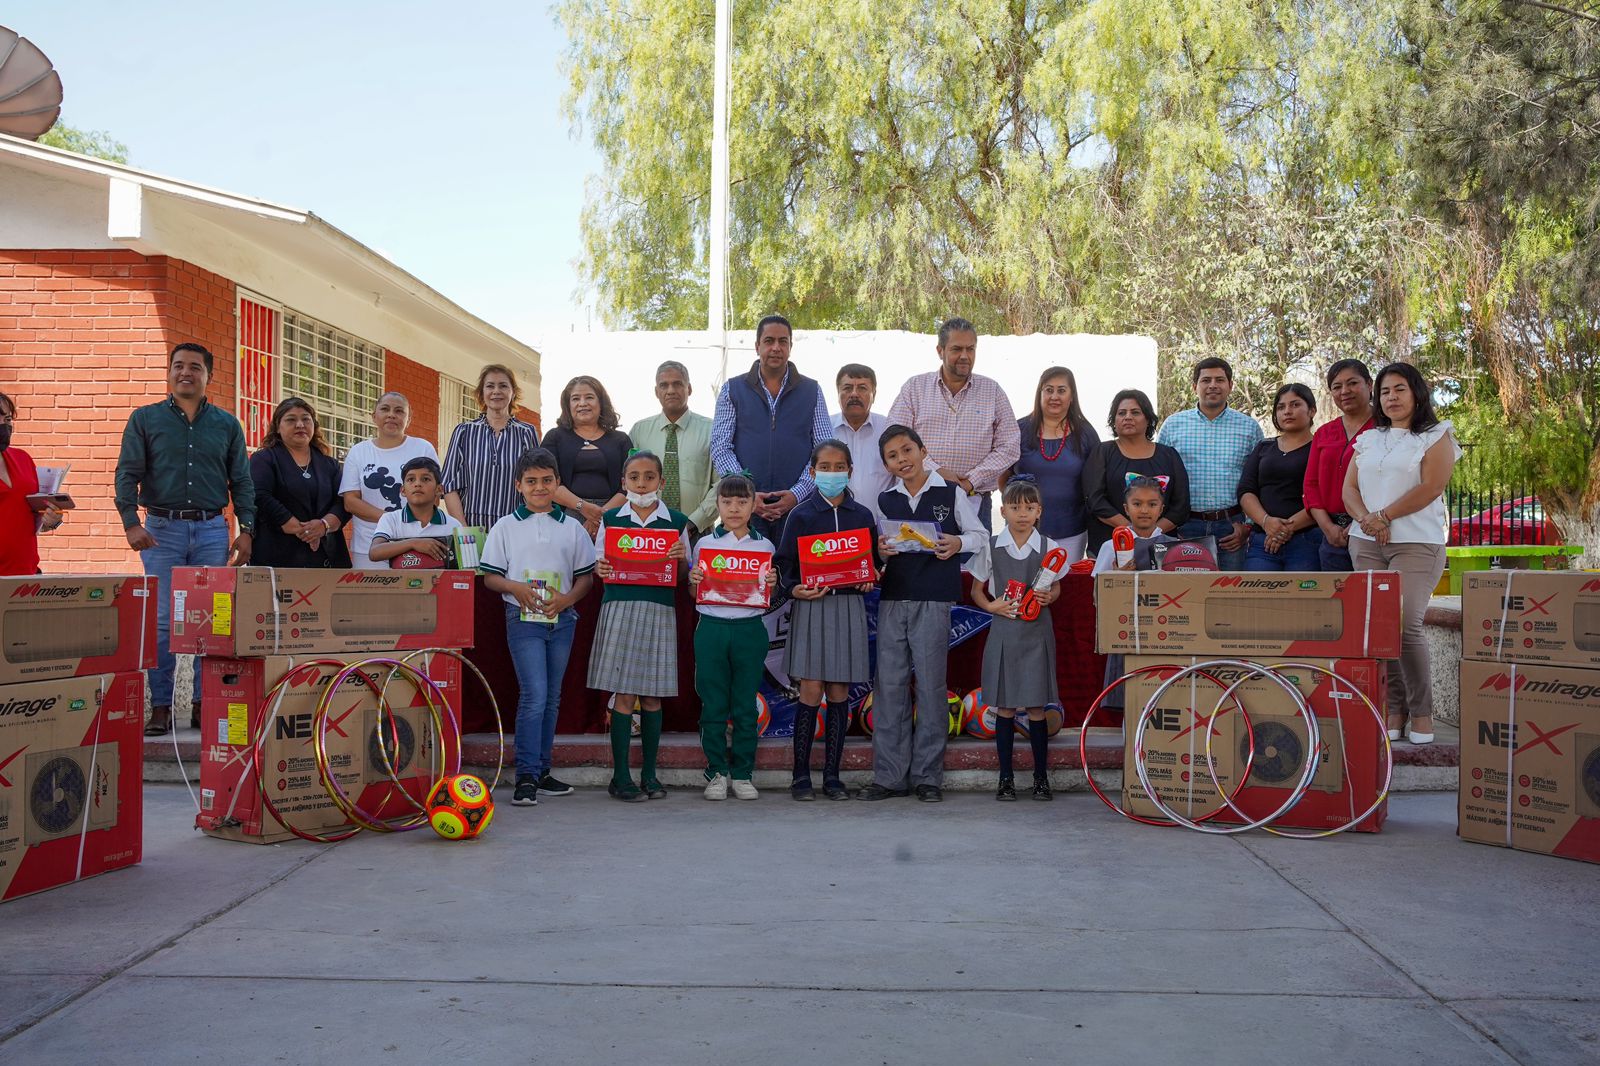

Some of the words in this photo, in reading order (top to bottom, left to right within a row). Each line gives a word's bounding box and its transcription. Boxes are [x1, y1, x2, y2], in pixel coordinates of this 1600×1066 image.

[361, 573, 400, 585] mirage
[1238, 578, 1290, 590] mirage
[36, 586, 80, 598] mirage
[1138, 587, 1192, 610] NEX
[1501, 592, 1559, 616] NEX
[317, 671, 379, 688] mage
[1523, 679, 1600, 700] mirage
[276, 698, 363, 745] NEX
[1143, 705, 1237, 743] NEX
[1478, 720, 1583, 757] NEX
[209, 745, 253, 773] NEX
[300, 775, 312, 783] MÁS
[1532, 776, 1545, 784] 50%
[1546, 778, 1557, 786] MÁS
[1466, 813, 1487, 824] MÁXIMO
[1516, 823, 1546, 833] EFICIENCIA
